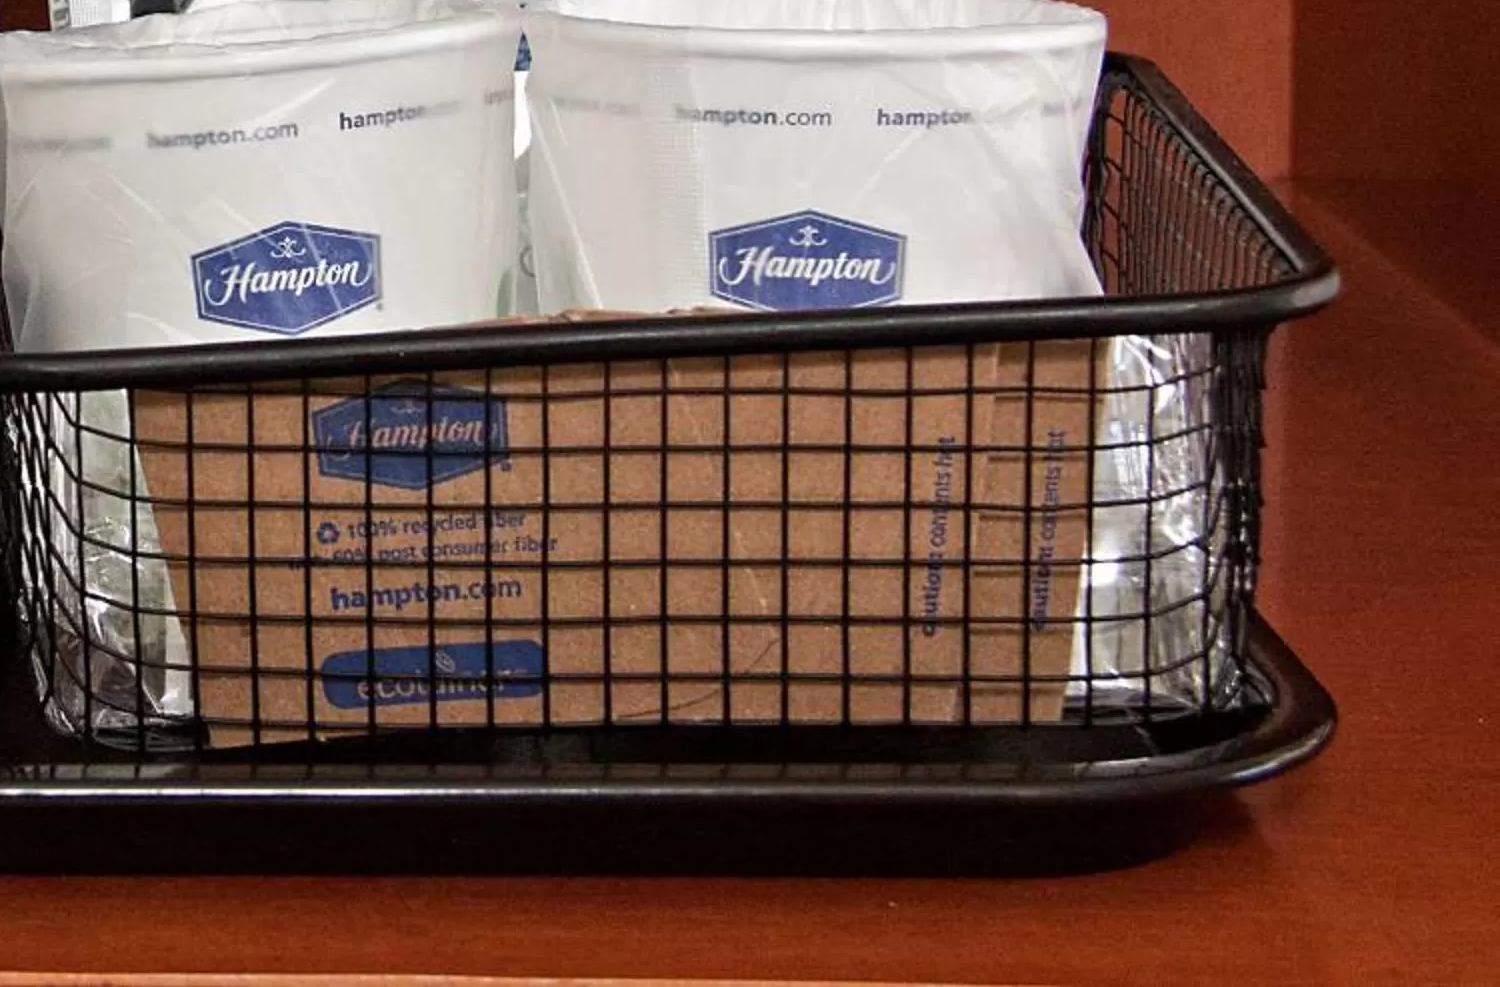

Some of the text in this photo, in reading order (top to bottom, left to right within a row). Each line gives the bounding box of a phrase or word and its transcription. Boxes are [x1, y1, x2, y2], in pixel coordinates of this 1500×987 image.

[676, 108, 833, 128] mpton.com
[718, 245, 897, 287] Hampton
[205, 257, 372, 307] Hampton
[935, 437, 954, 467] ht
[403, 512, 477, 535] recycled
[481, 510, 526, 529] ber
[330, 578, 522, 611] hampton.com
